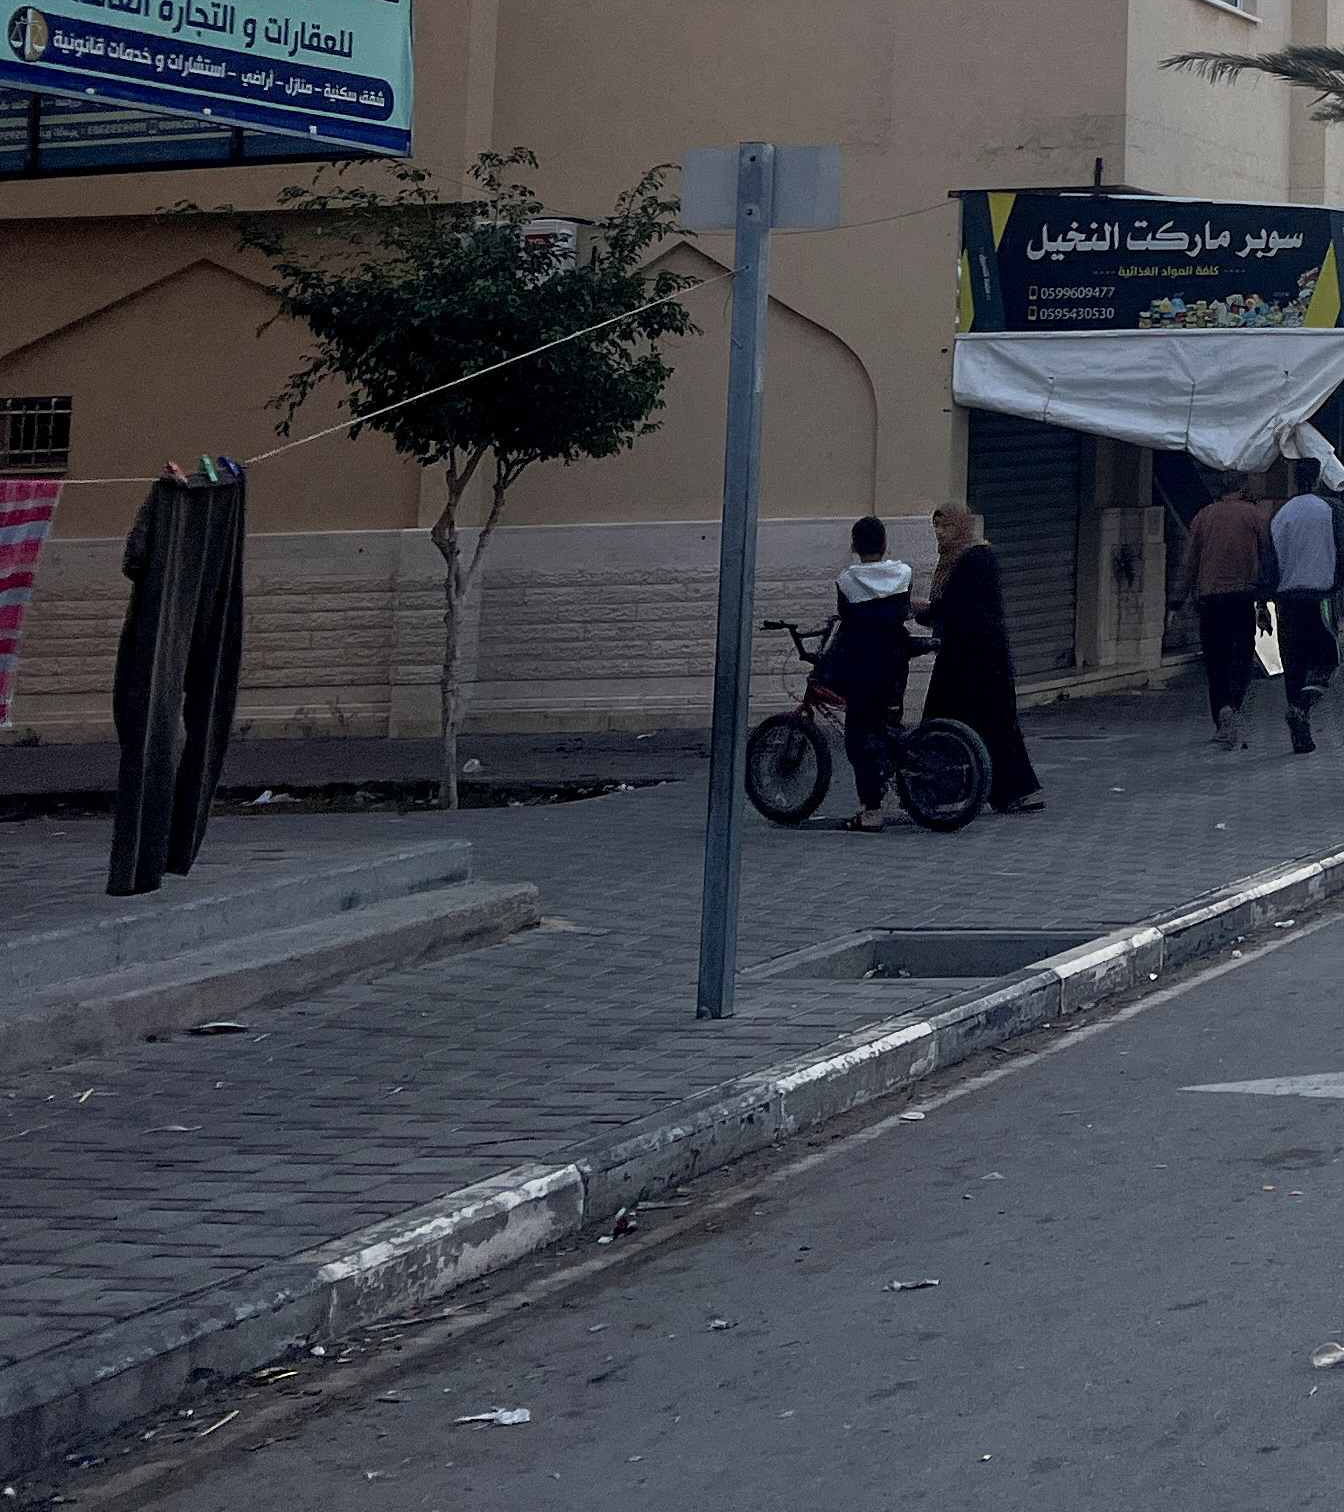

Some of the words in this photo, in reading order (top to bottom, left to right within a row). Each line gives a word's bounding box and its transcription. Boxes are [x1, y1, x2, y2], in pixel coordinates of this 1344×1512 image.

[53, 30, 105, 57] قانونية
[243, 16, 256, 48] و
[264, 14, 353, 58] للعقارات
[107, 42, 152, 66] خدمات
[156, 55, 165, 72] و
[167, 54, 227, 79] استشارات
[241, 69, 274, 92] أراضي
[285, 77, 313, 96] منازل
[323, 82, 358, 103] سكنية
[359, 88, 385, 108] شقق
[1026, 221, 1119, 260] النخيل
[1126, 220, 1229, 258] ماركت
[1235, 229, 1304, 258] سوبر
[1117, 265, 1159, 279] الغذائية
[1040, 286, 1116, 300] 0599609477
[1039, 307, 1115, 320] 0595430530
